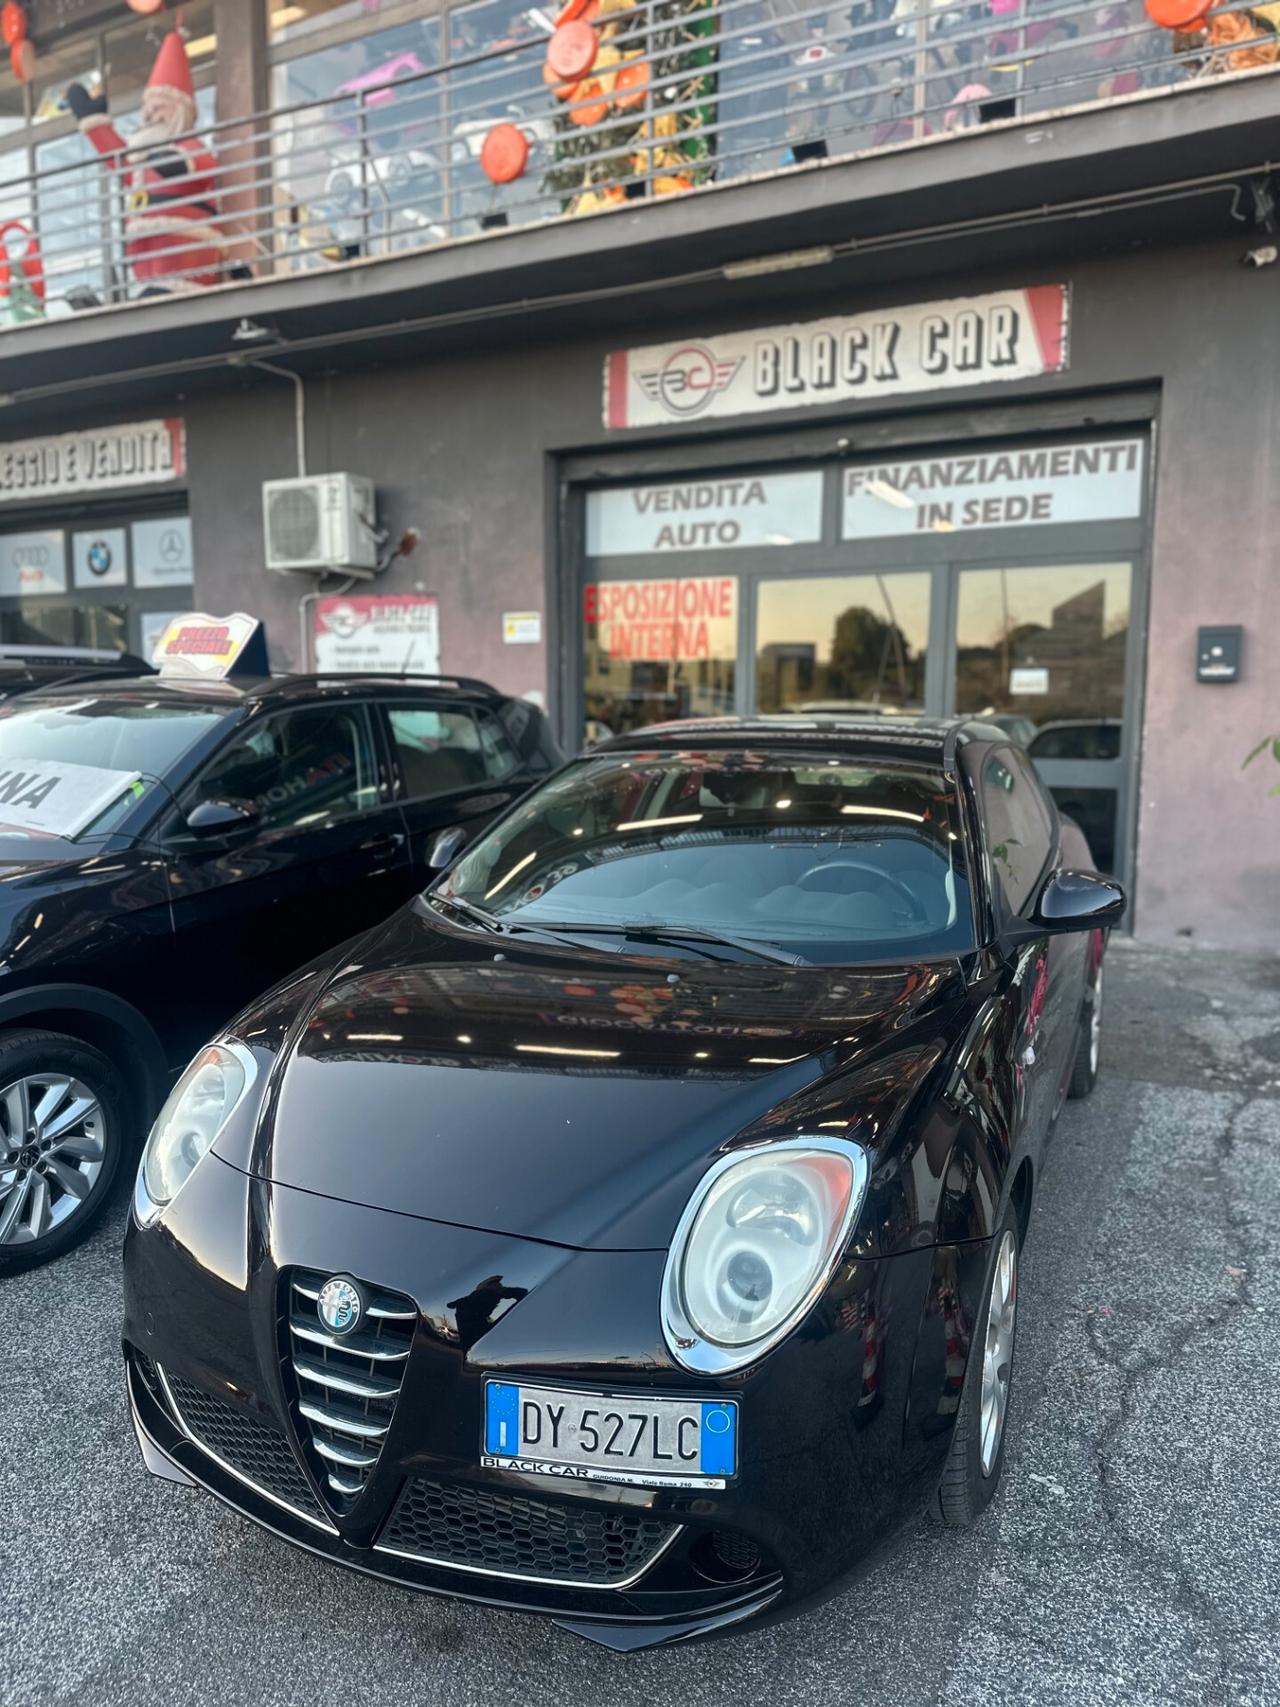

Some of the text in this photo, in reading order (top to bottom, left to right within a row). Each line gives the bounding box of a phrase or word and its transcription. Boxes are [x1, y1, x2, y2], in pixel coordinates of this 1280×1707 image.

[753, 321, 900, 397] BLACK
[918, 304, 1020, 373] CAR
[0, 431, 172, 490] EGGIO E VENDITA
[846, 444, 1139, 497] FINANZIAMENTI
[632, 480, 768, 515] VENDITA
[915, 493, 1054, 530] IN SEDE
[654, 519, 741, 549] AUTO
[583, 579, 733, 624] ESPOSIZIONE
[608, 621, 710, 660] INTERNA
[0, 770, 62, 809] NA
[522, 1401, 565, 1448] DY
[579, 1410, 699, 1461] 527LC
[482, 1457, 544, 1473] BLACK
[549, 1465, 588, 1478] CAR
